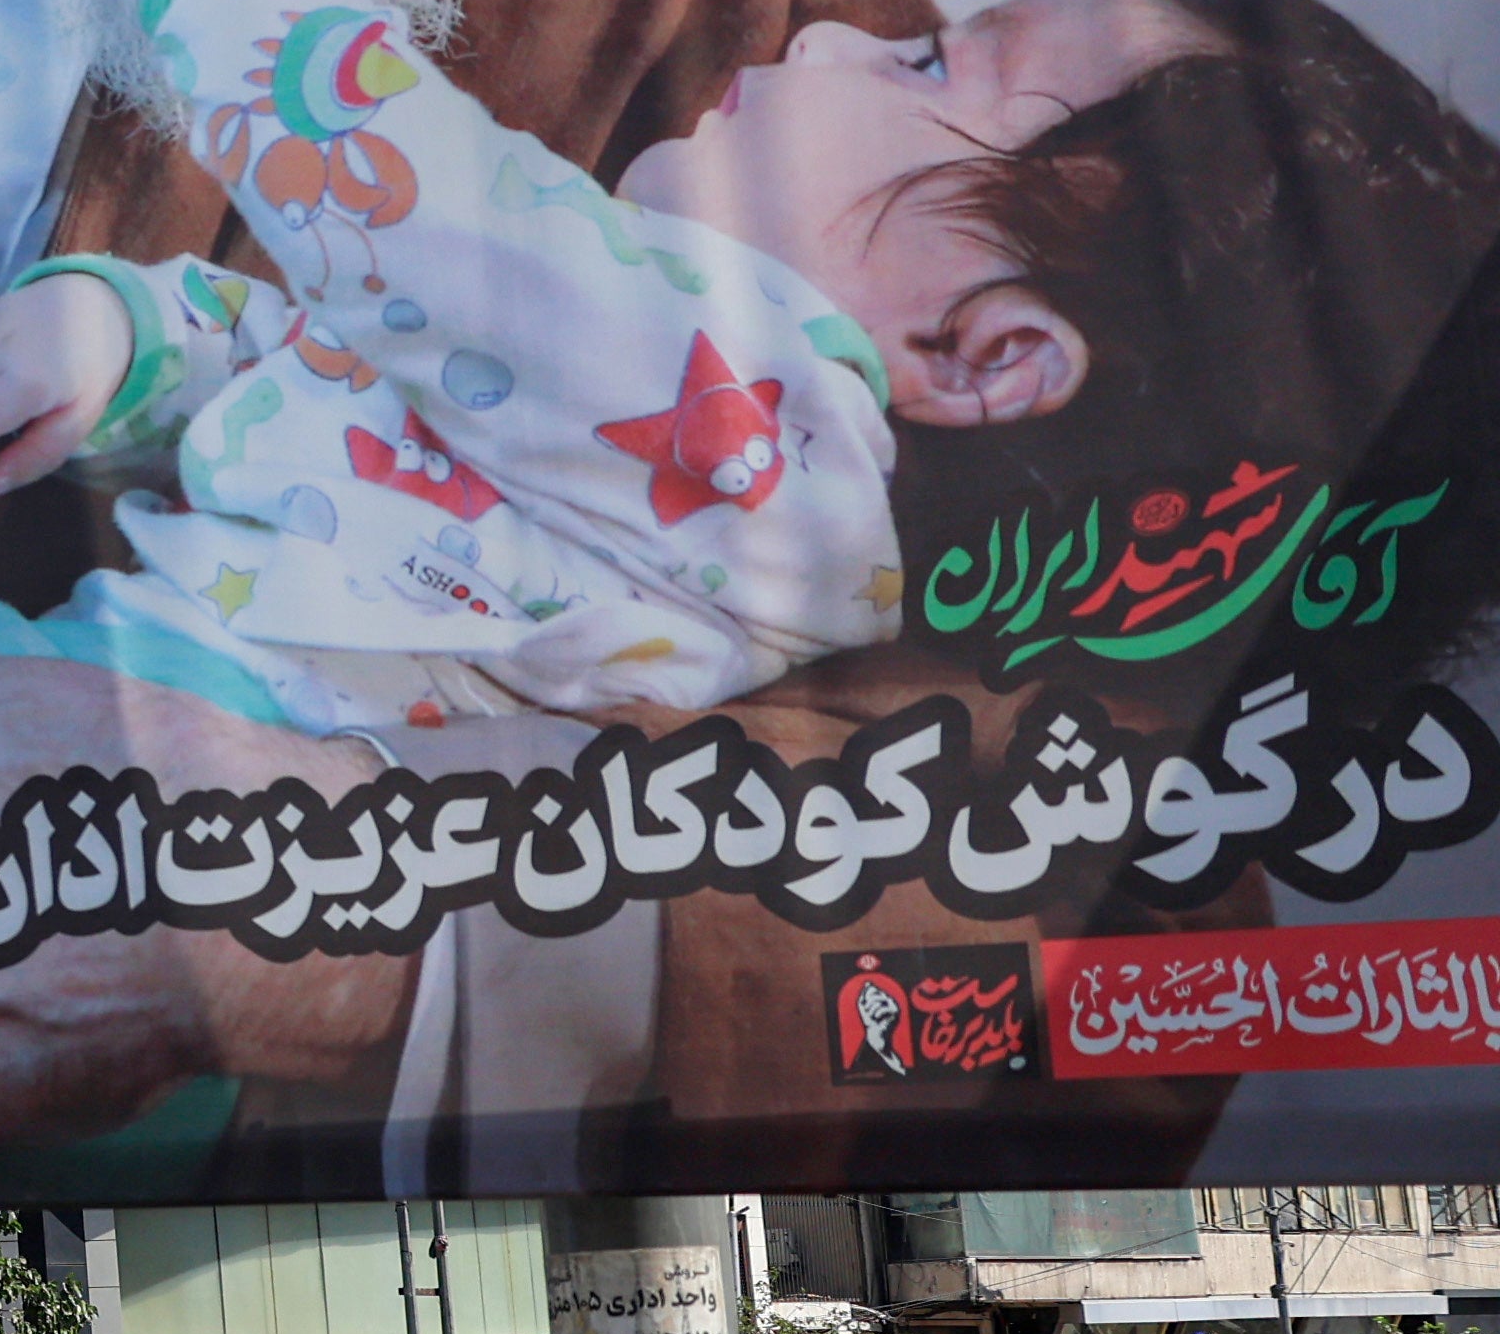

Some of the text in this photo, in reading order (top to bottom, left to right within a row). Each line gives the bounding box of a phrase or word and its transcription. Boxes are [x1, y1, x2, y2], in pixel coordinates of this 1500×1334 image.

[924, 496, 1100, 671] ایران
[1069, 460, 1299, 632] شهید
[154, 793, 501, 939] عزیزت
[513, 722, 943, 907] کودکان
[948, 673, 1309, 893] گوش
[1295, 713, 1473, 873] در
[606, 1288, 665, 1317] اداری
[671, 1286, 718, 1313] واحد
